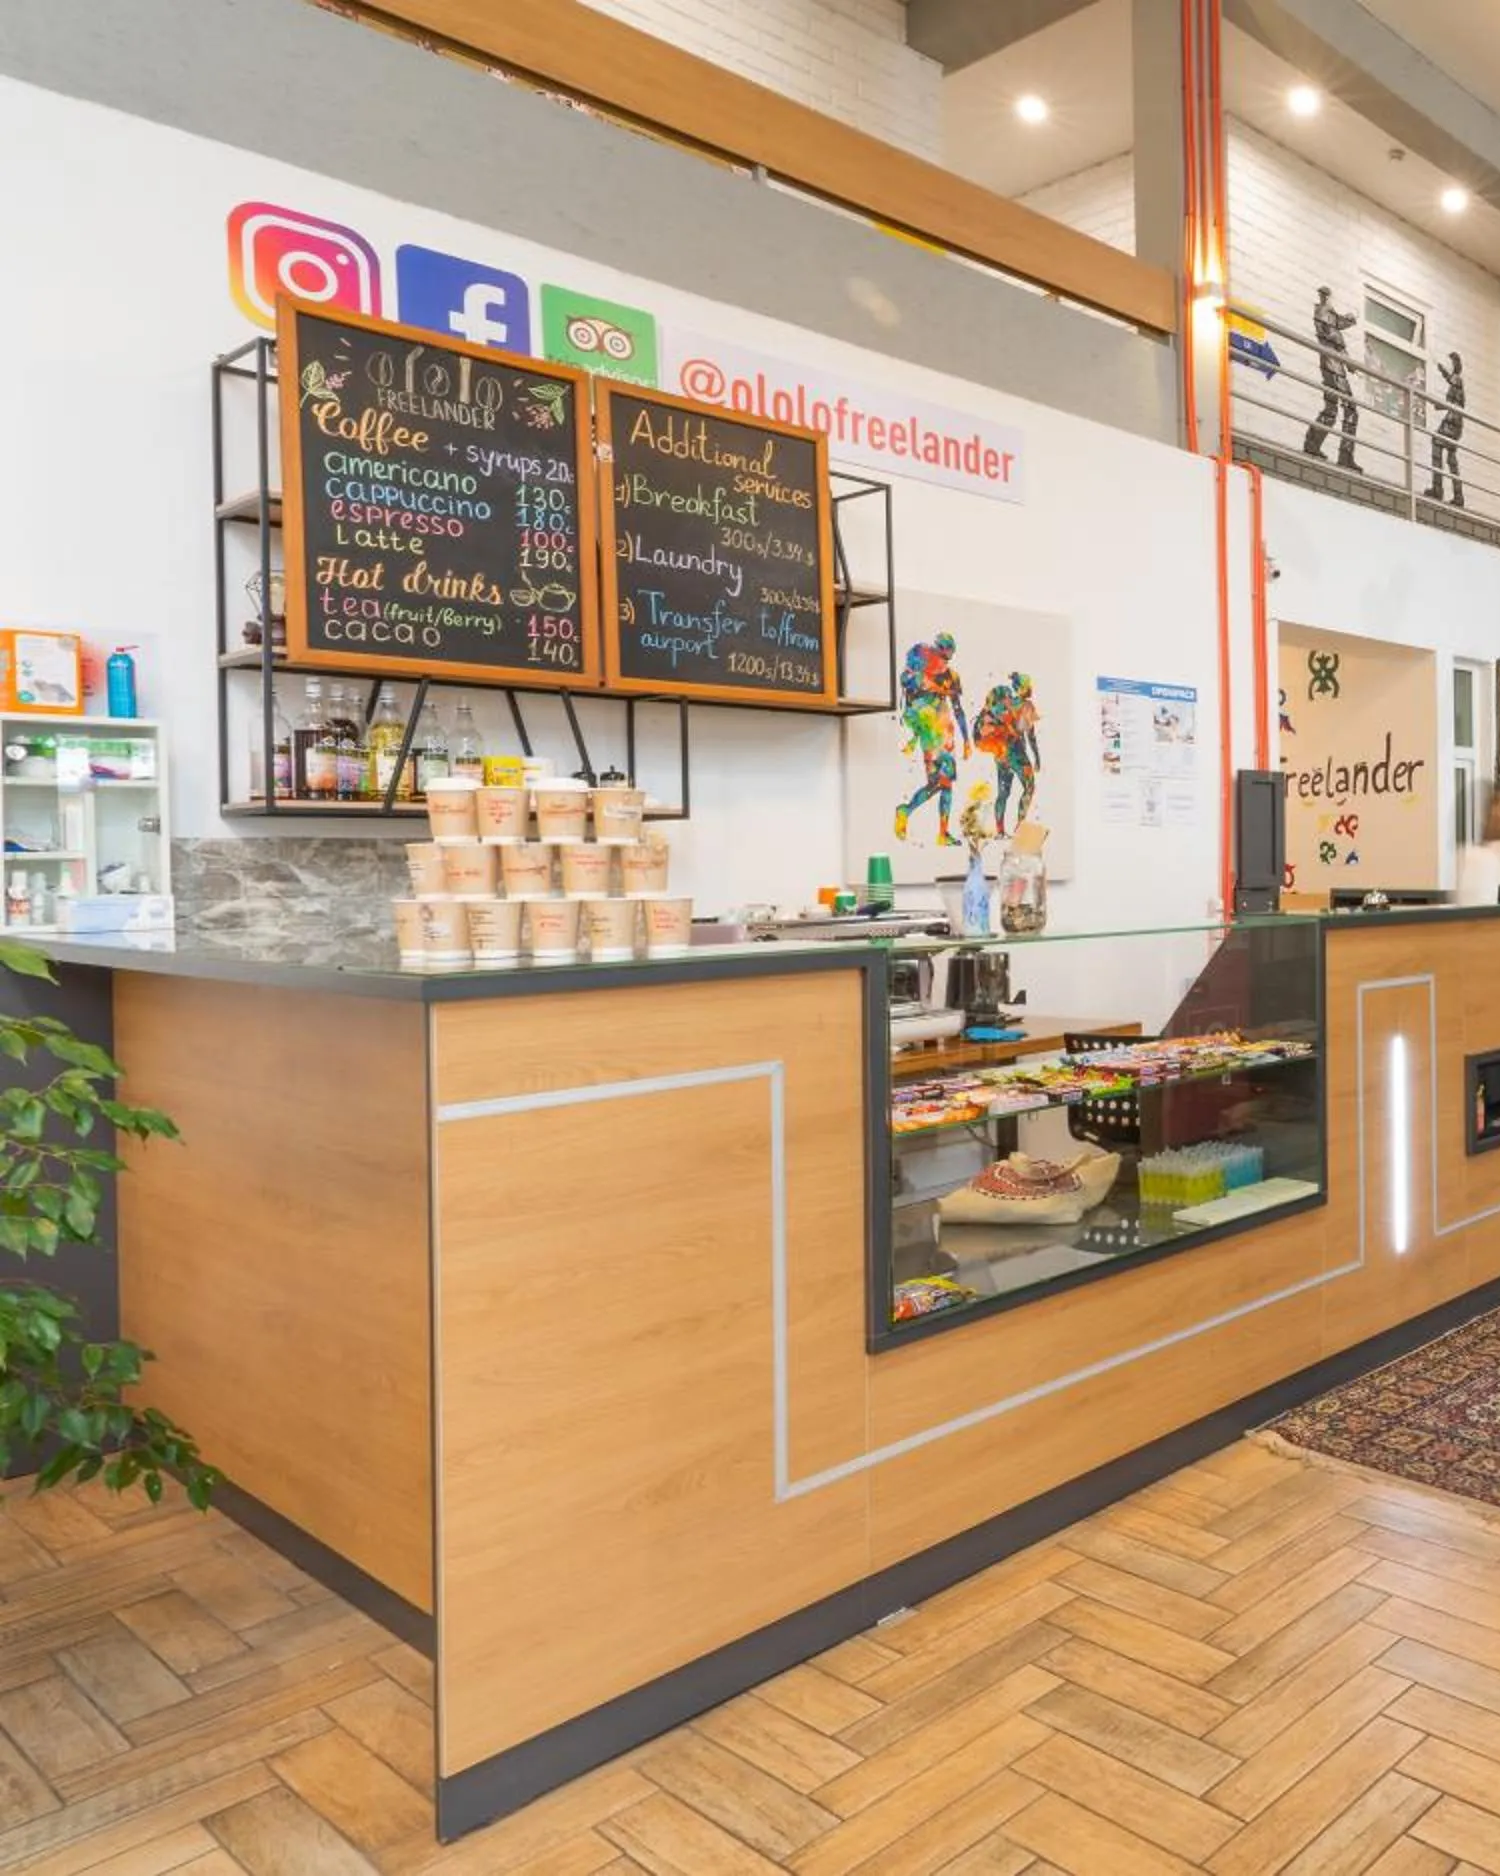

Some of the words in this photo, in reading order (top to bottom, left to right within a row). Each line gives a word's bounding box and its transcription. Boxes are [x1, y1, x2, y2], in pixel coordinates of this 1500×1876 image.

[311, 402, 430, 455] Coffee
[377, 387, 496, 431] FREELANDER
[680, 359, 1014, 483] @ololofreelander
[466, 444, 541, 482] syrups
[629, 408, 776, 480] Additional
[633, 472, 760, 527] Breakfast
[733, 474, 813, 509] services
[330, 499, 465, 537] espresso
[315, 556, 385, 592] Hot
[402, 560, 503, 605] drinks
[635, 533, 743, 597] Laundry
[324, 619, 442, 648] cacao
[636, 588, 748, 639] Transfer
[640, 630, 720, 669] airport
[1280, 731, 1425, 799] reelander
